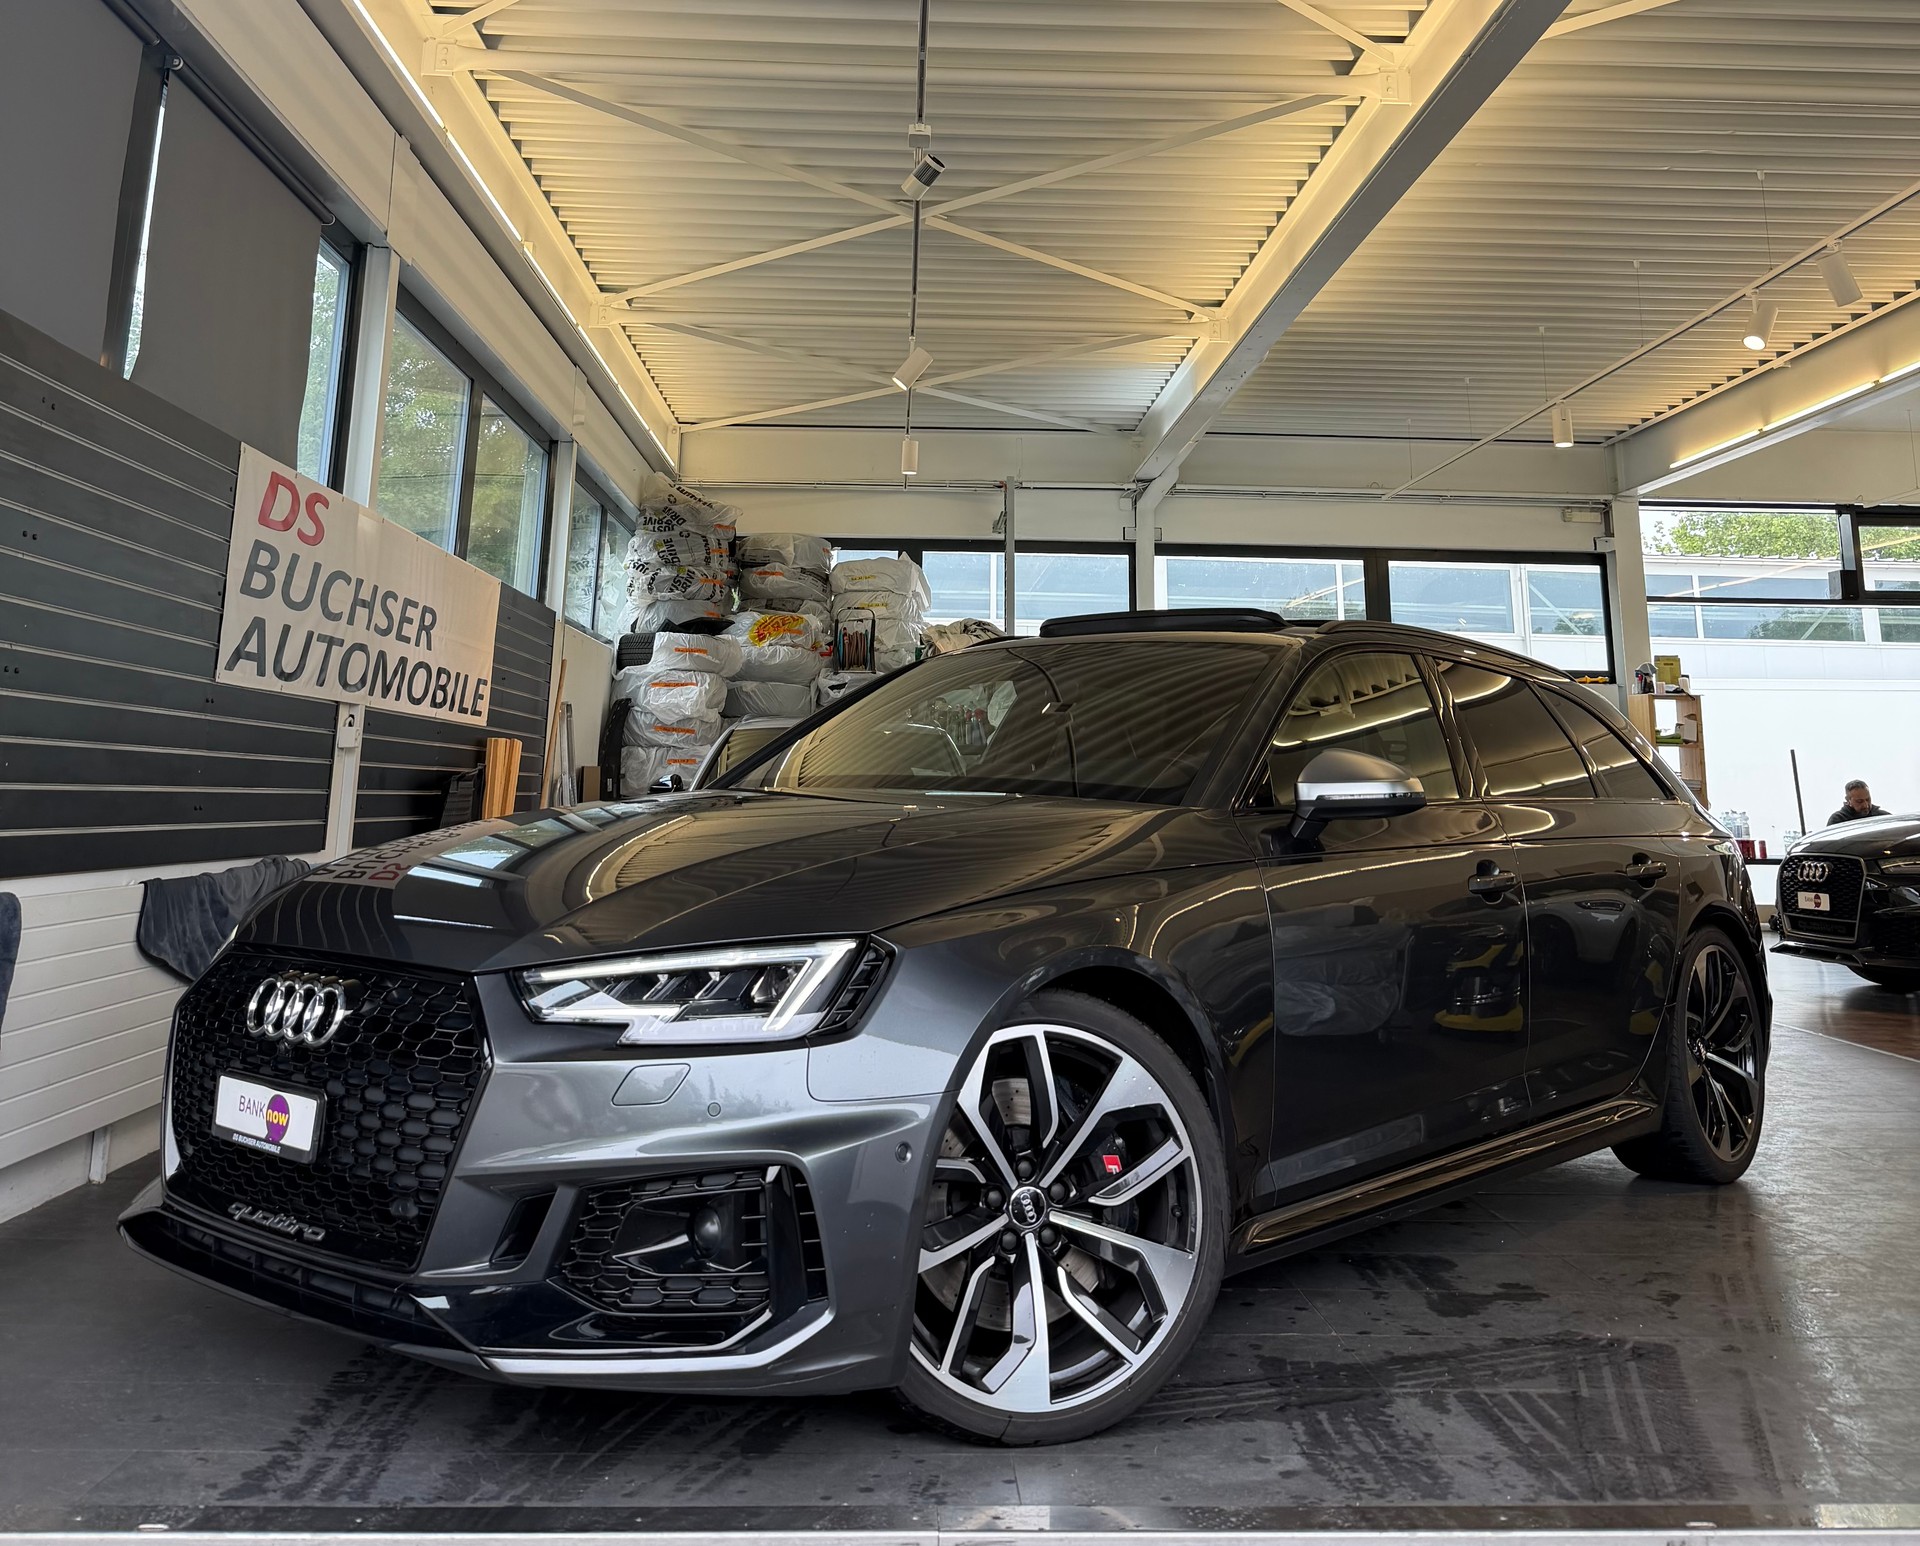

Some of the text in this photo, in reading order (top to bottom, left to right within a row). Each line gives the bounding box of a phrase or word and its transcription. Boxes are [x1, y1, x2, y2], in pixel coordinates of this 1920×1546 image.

[258, 471, 330, 546] DS
[240, 539, 437, 651] BUCHSER
[224, 616, 488, 717] AUTOMOBILE
[238, 1095, 289, 1127] BANK now
[227, 1201, 326, 1241] quattro
